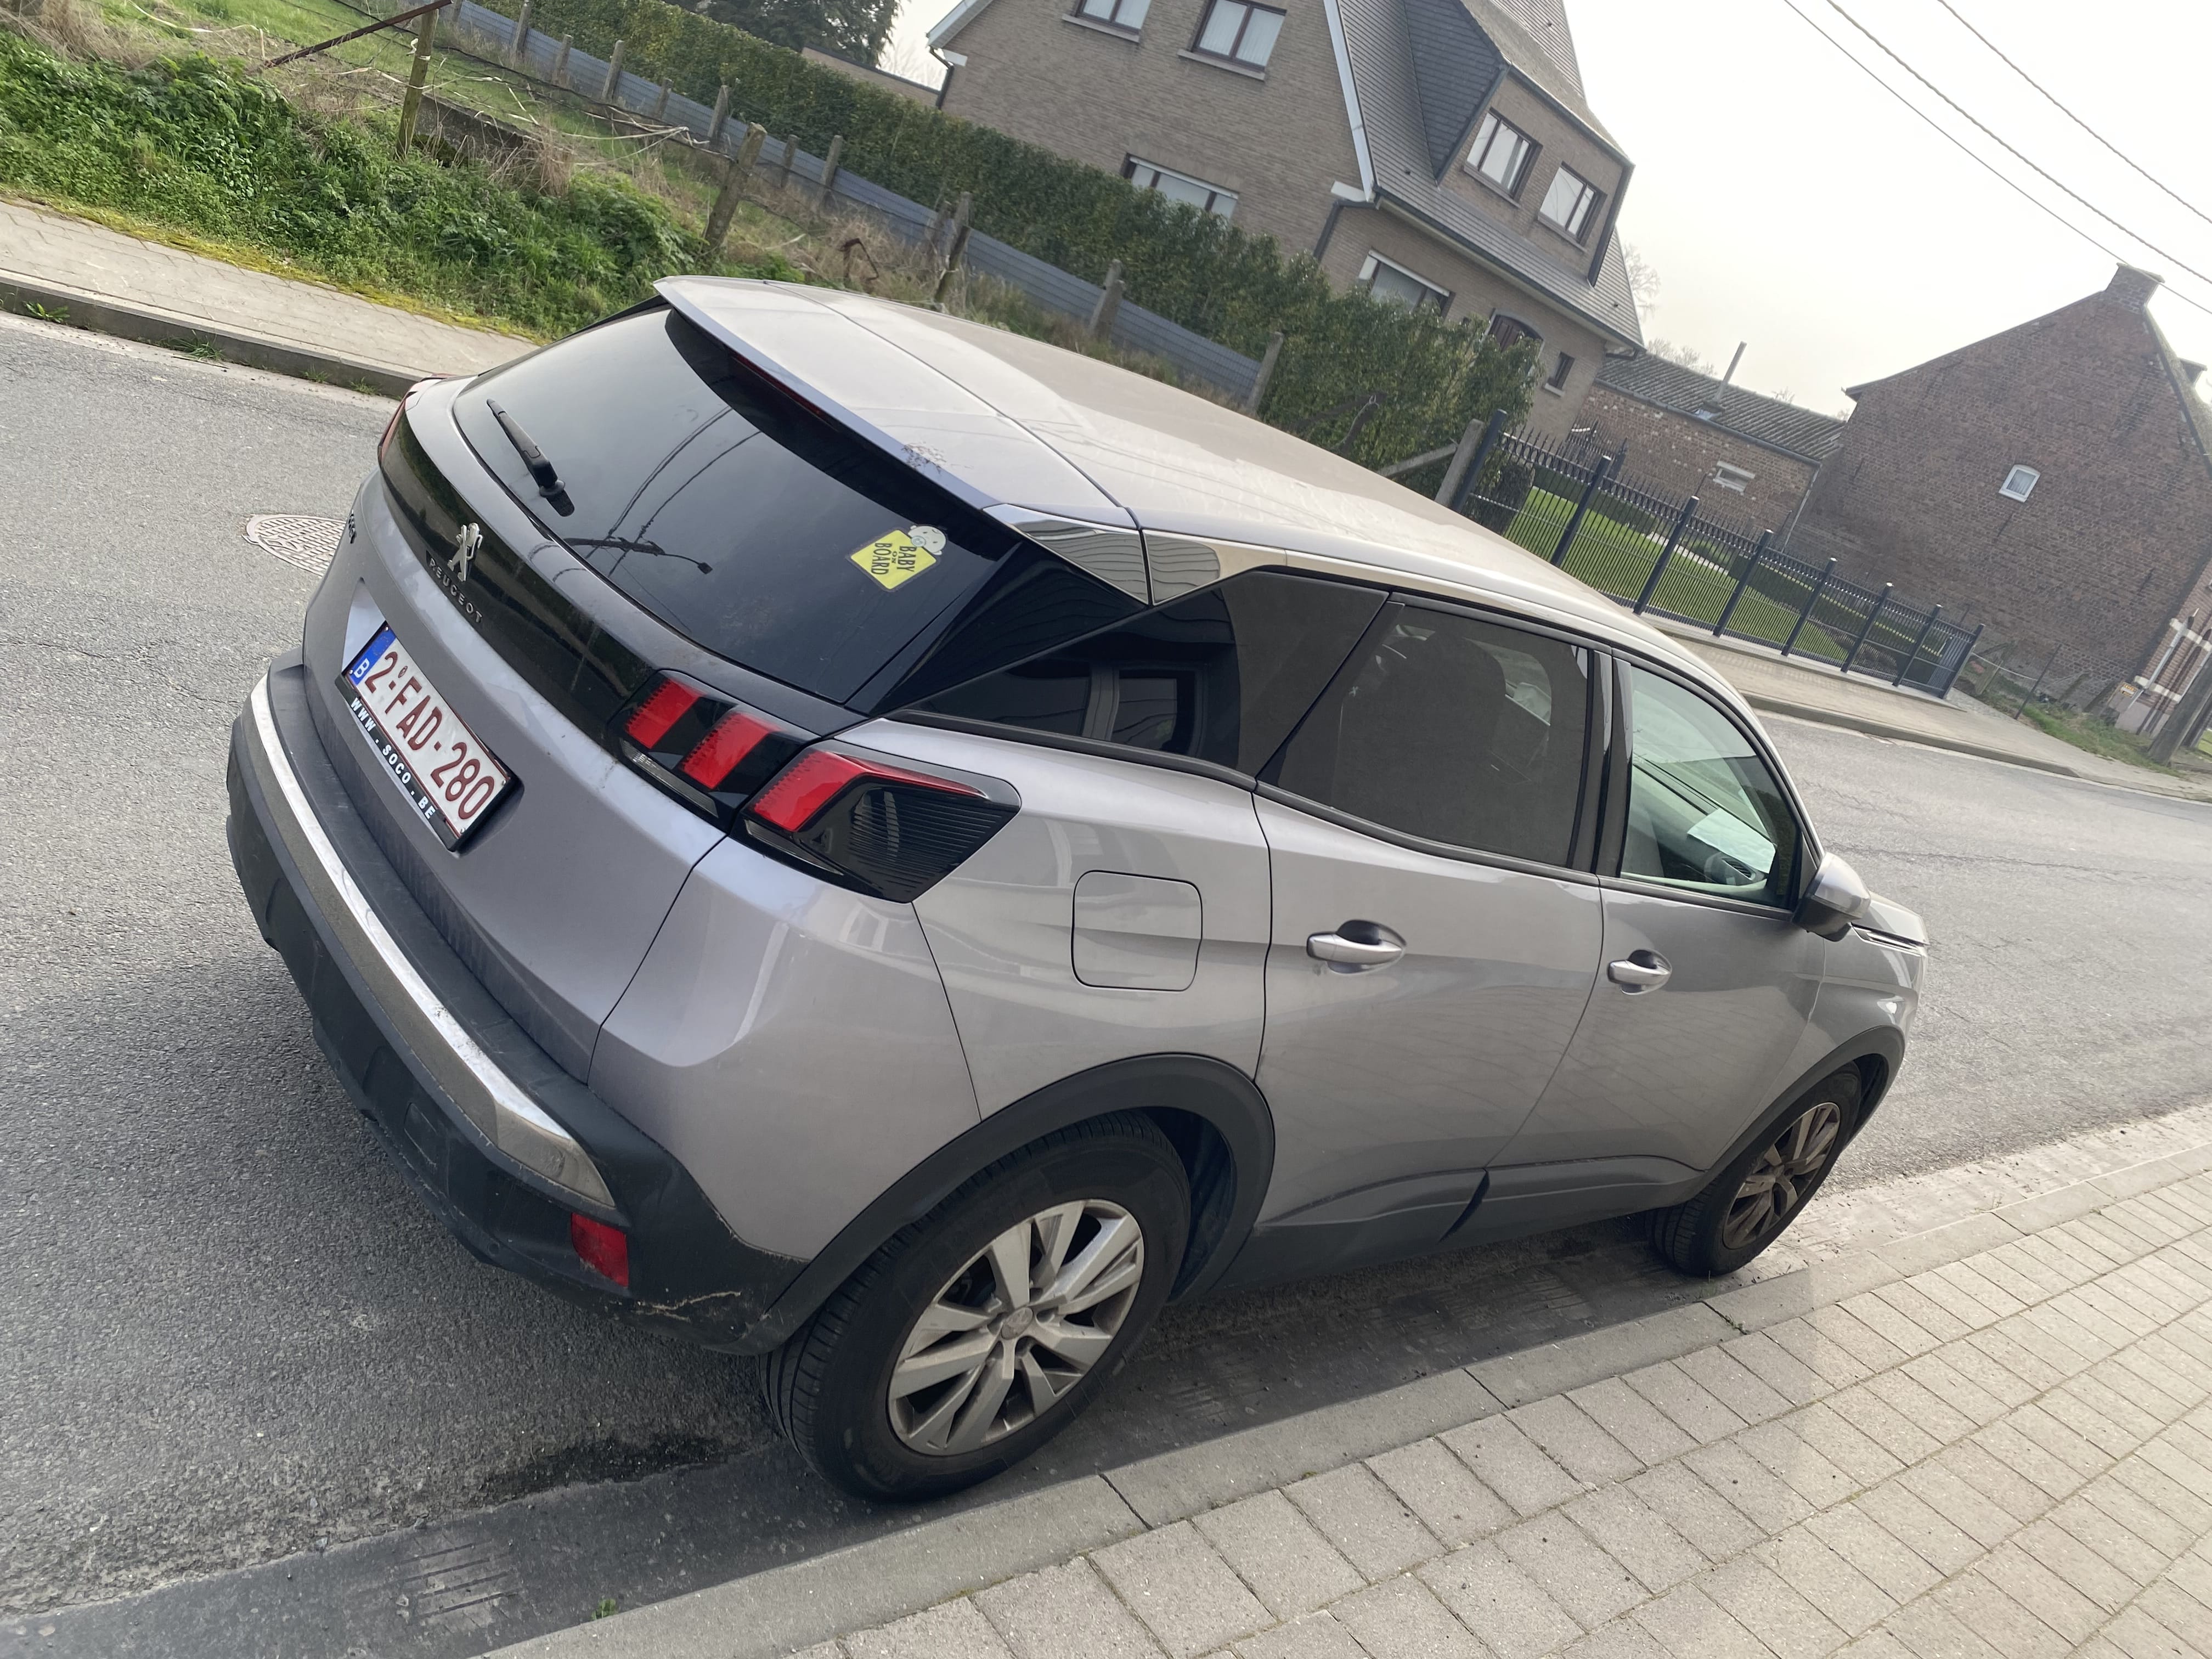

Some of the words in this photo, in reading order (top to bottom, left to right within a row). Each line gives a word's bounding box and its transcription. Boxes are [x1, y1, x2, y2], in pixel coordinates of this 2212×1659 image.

[871, 543, 893, 575] BOARD
[891, 551, 898, 563] ON
[897, 546, 917, 572] BABY
[429, 557, 483, 623] PEUGEOT
[354, 658, 370, 678] B
